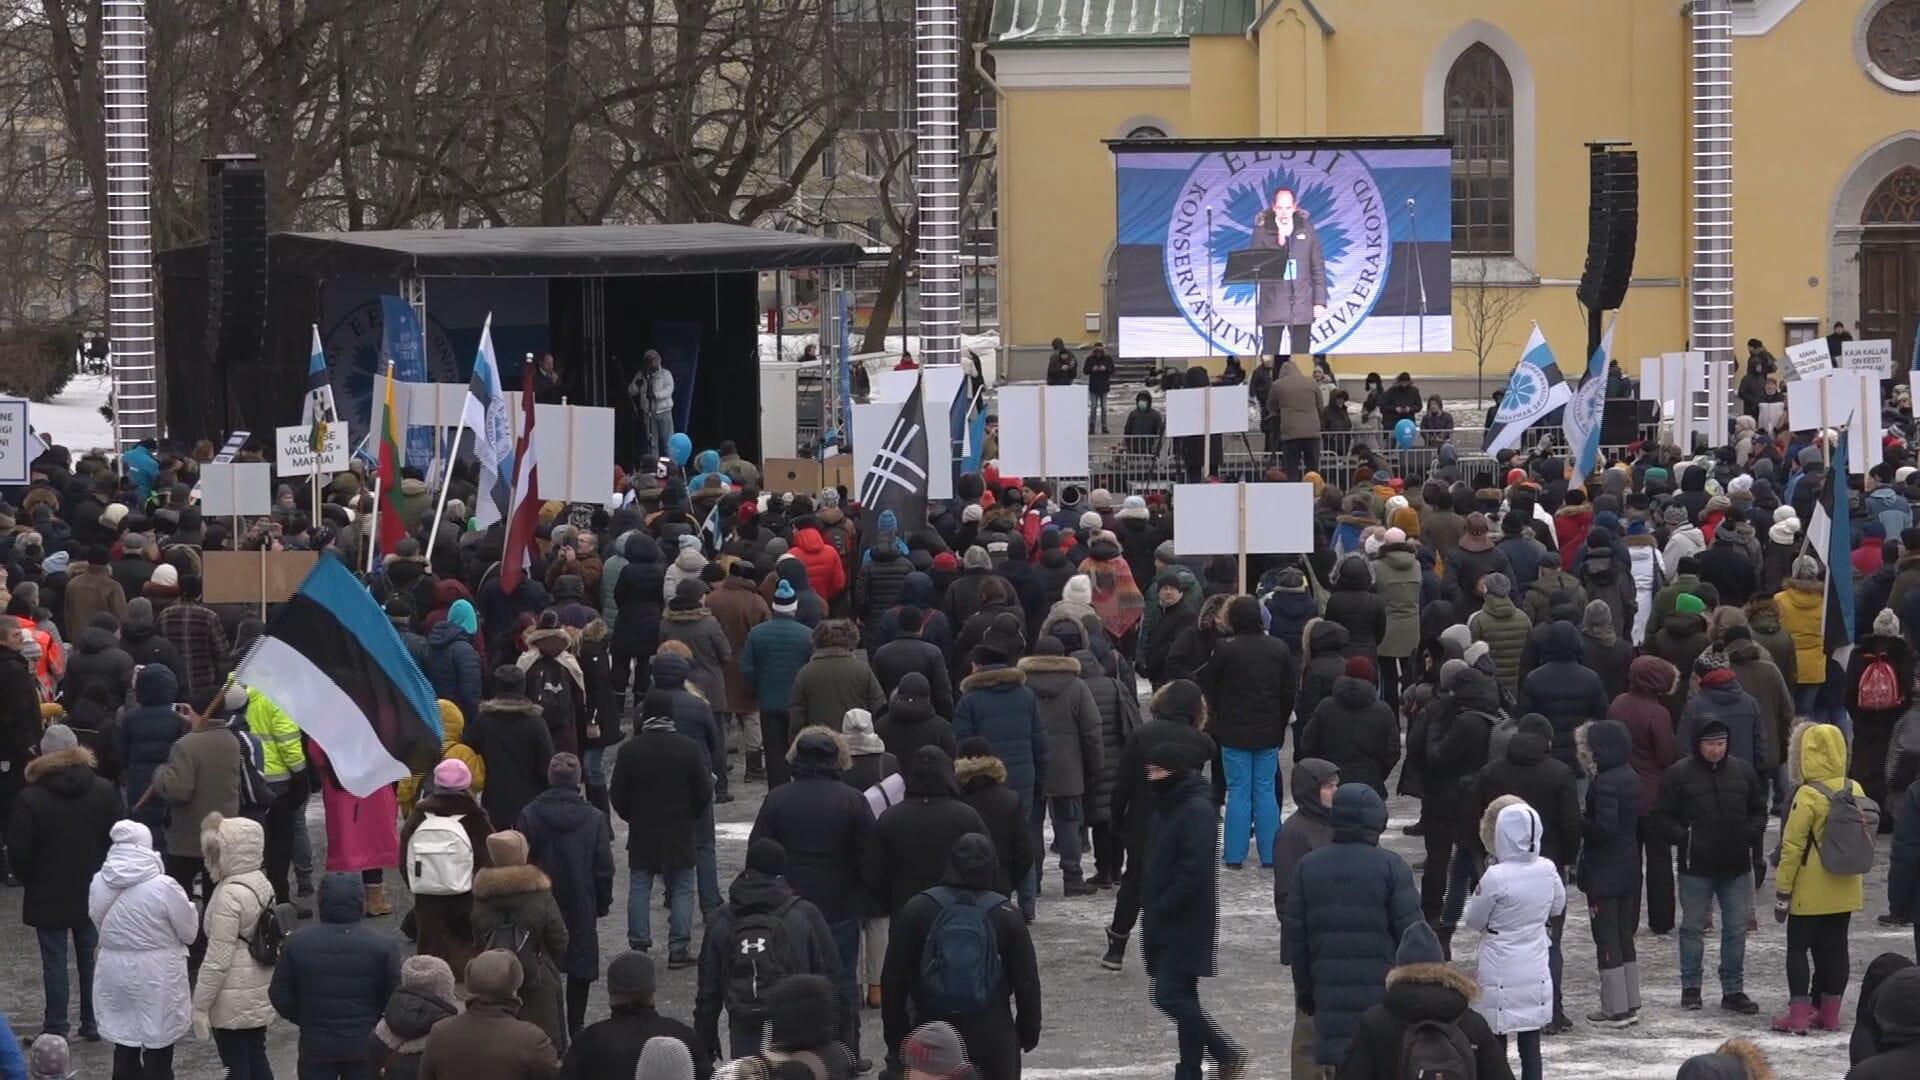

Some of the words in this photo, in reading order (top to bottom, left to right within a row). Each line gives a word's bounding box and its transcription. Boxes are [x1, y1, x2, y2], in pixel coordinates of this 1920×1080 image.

[1173, 182, 1264, 350] KONSERVATIIVN
[1309, 179, 1382, 344] HVAERAKOND
[284, 443, 333, 456] VALITS
[290, 431, 336, 443] KALSE
